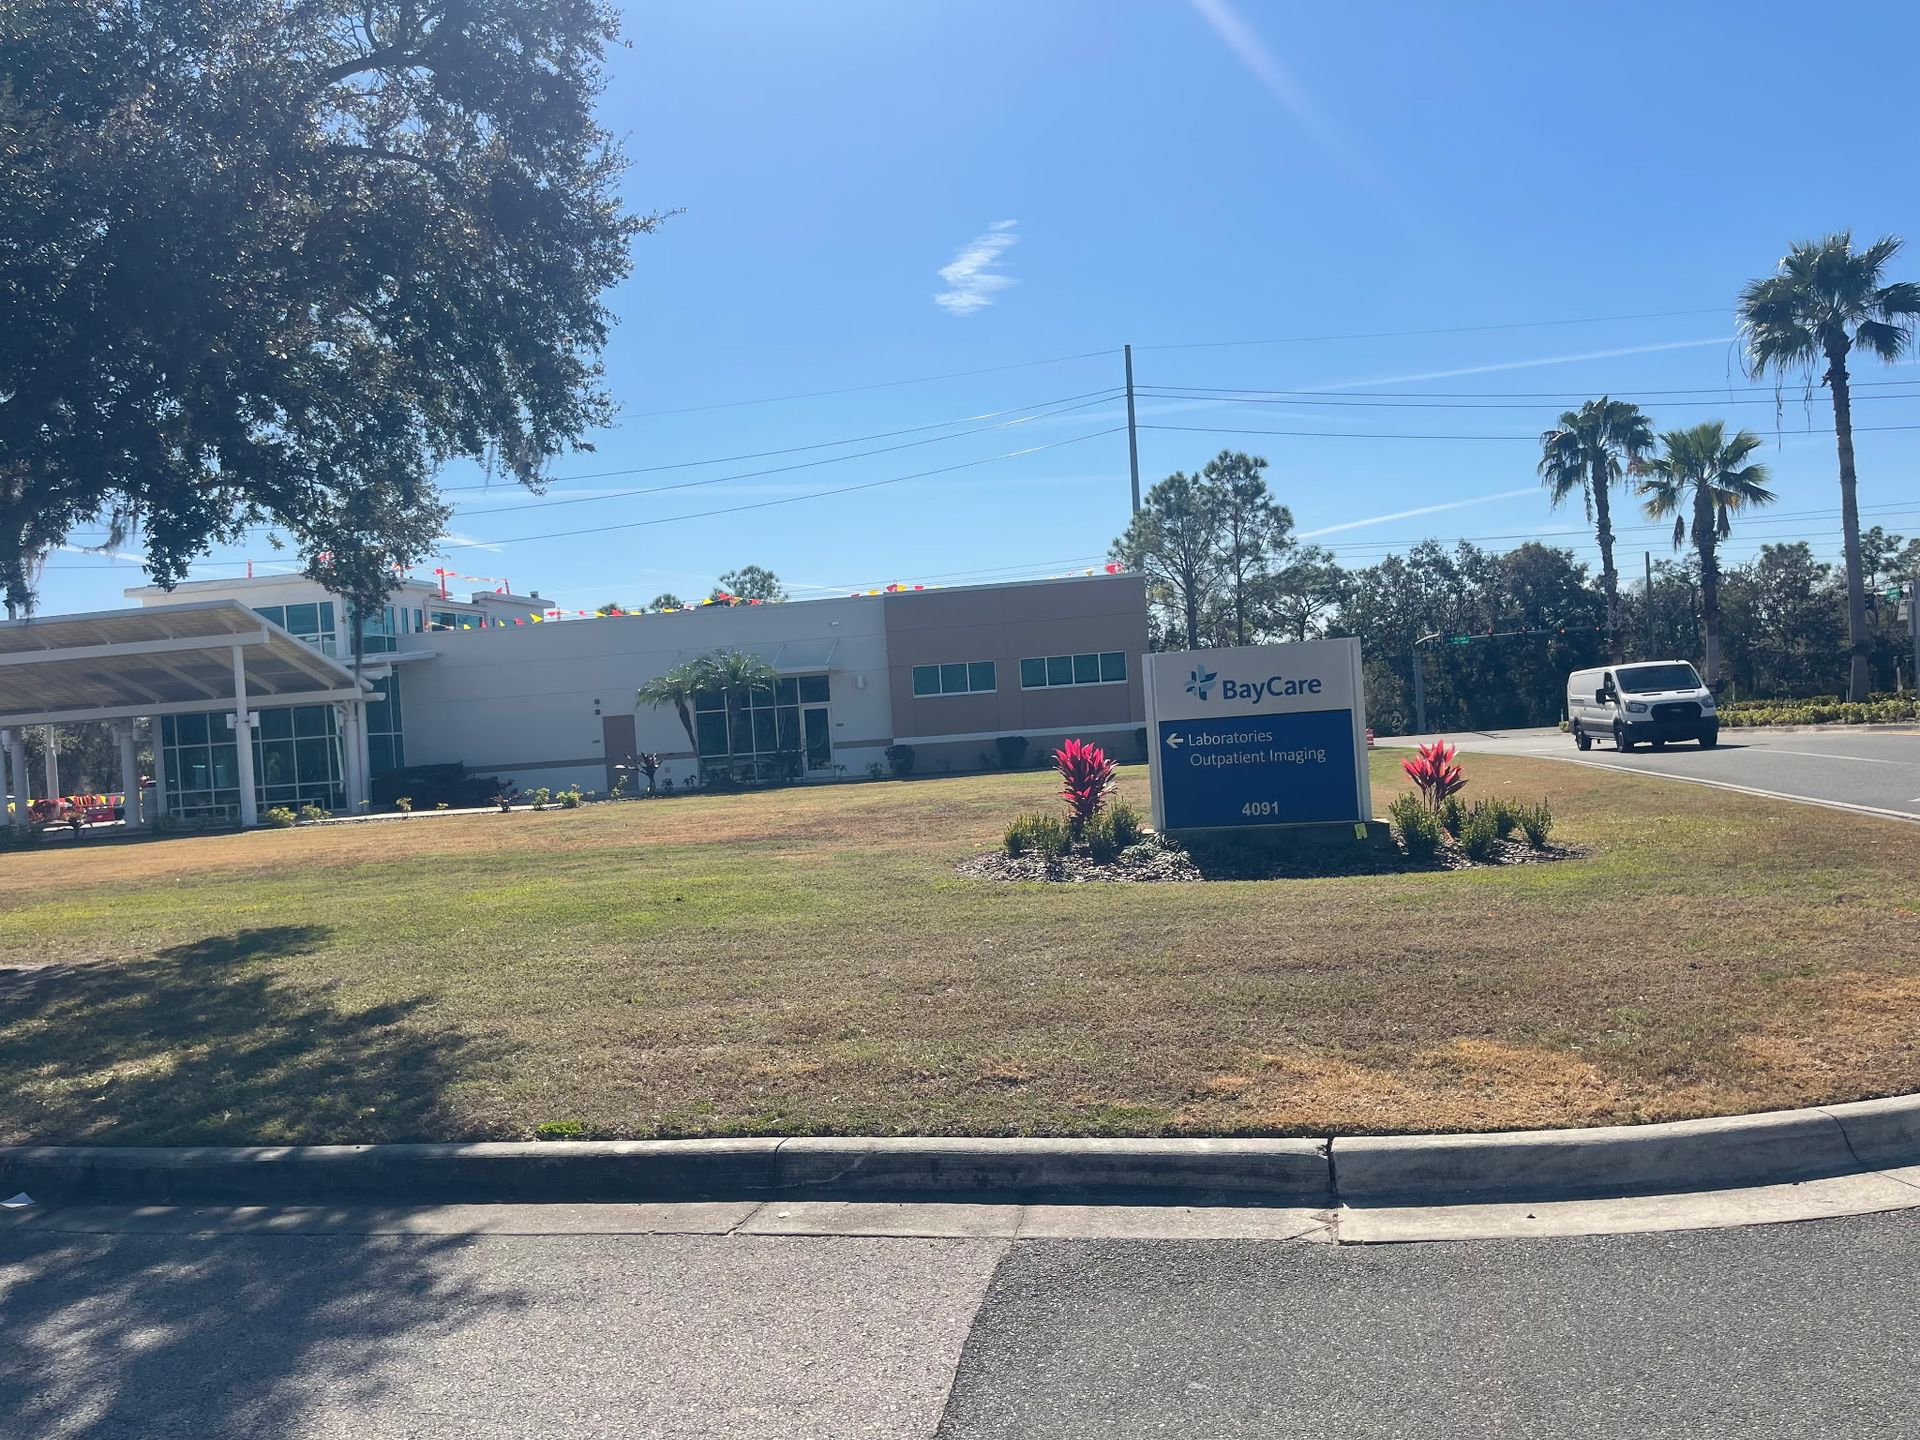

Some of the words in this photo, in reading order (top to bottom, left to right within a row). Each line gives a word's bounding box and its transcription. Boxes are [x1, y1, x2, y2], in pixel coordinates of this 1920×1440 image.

[1222, 676, 1322, 704] BayCare
[1188, 730, 1273, 746] Laboratories
[1190, 750, 1266, 768] Outpatient
[1269, 747, 1326, 764] Imaging
[1241, 801, 1280, 816] 4091
